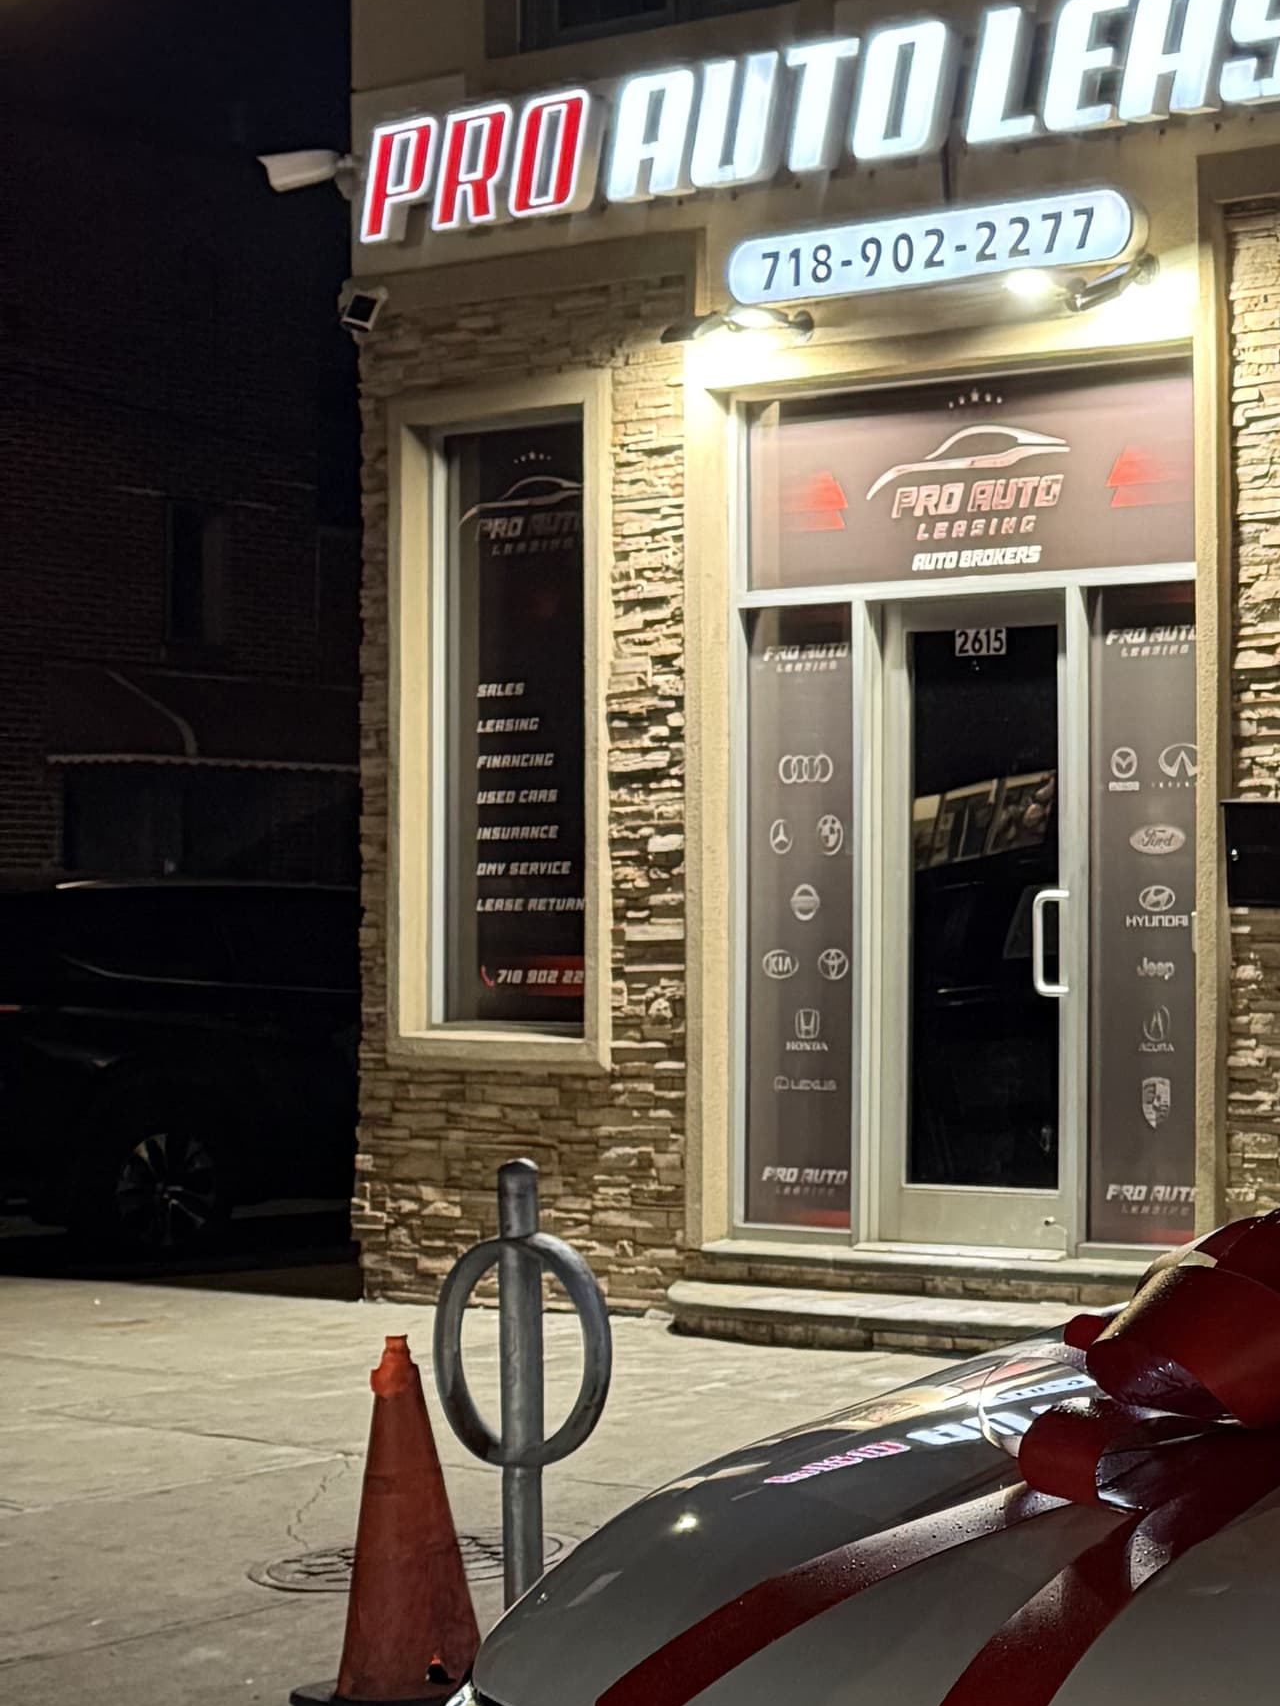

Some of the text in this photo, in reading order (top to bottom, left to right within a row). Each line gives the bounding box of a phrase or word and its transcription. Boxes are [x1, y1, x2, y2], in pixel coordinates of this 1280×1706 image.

[361, 87, 592, 244] PRO
[606, 20, 950, 203] AUTO
[760, 207, 1096, 291] 718-902-2277
[891, 474, 1064, 519] PRO AUTO
[916, 515, 1037, 541] LEASING
[912, 545, 1043, 572] AUTO BROKERS
[957, 628, 1005, 655] 2615
[476, 682, 526, 698] SALES
[476, 717, 540, 734] LEASING
[476, 752, 555, 770] FINANCING
[476, 790, 516, 805] USED
[476, 824, 560, 841] INSURANCE
[509, 860, 573, 876] SERVICE
[476, 898, 526, 912] LEASE
[1125, 915, 1189, 927] HYUNDAI
[1137, 957, 1175, 980] Jeep
